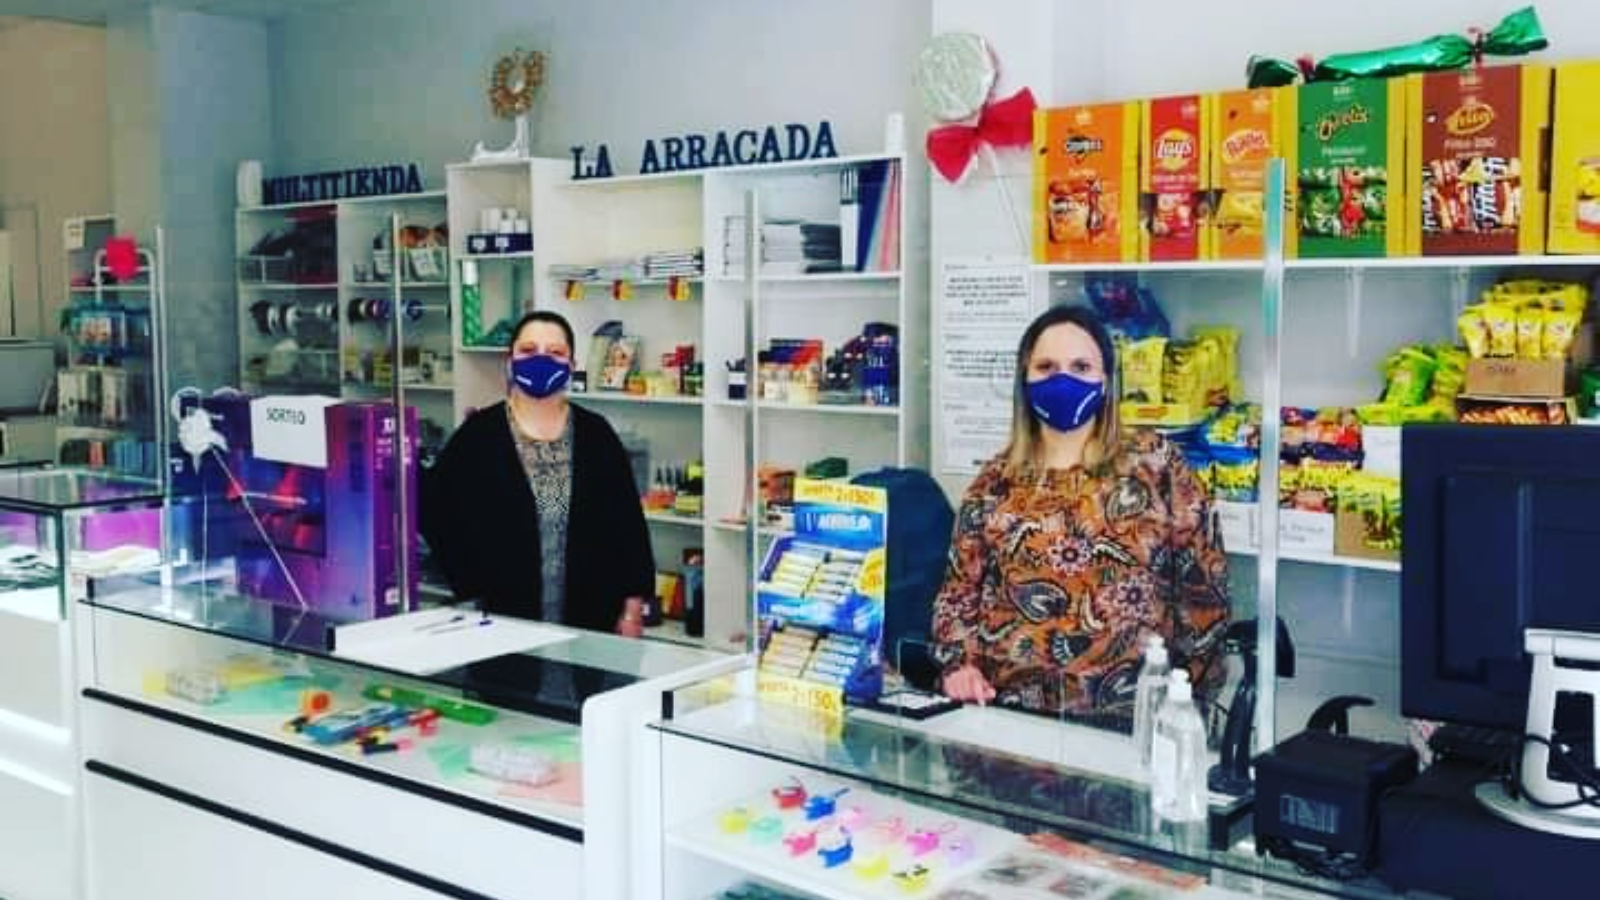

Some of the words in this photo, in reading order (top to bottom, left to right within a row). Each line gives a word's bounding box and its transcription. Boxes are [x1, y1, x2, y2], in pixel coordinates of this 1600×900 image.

[571, 145, 614, 180] LA
[639, 121, 838, 175] ARRACADA
[262, 163, 423, 205] MULTITIENDA
[265, 407, 306, 426] SORTEO
